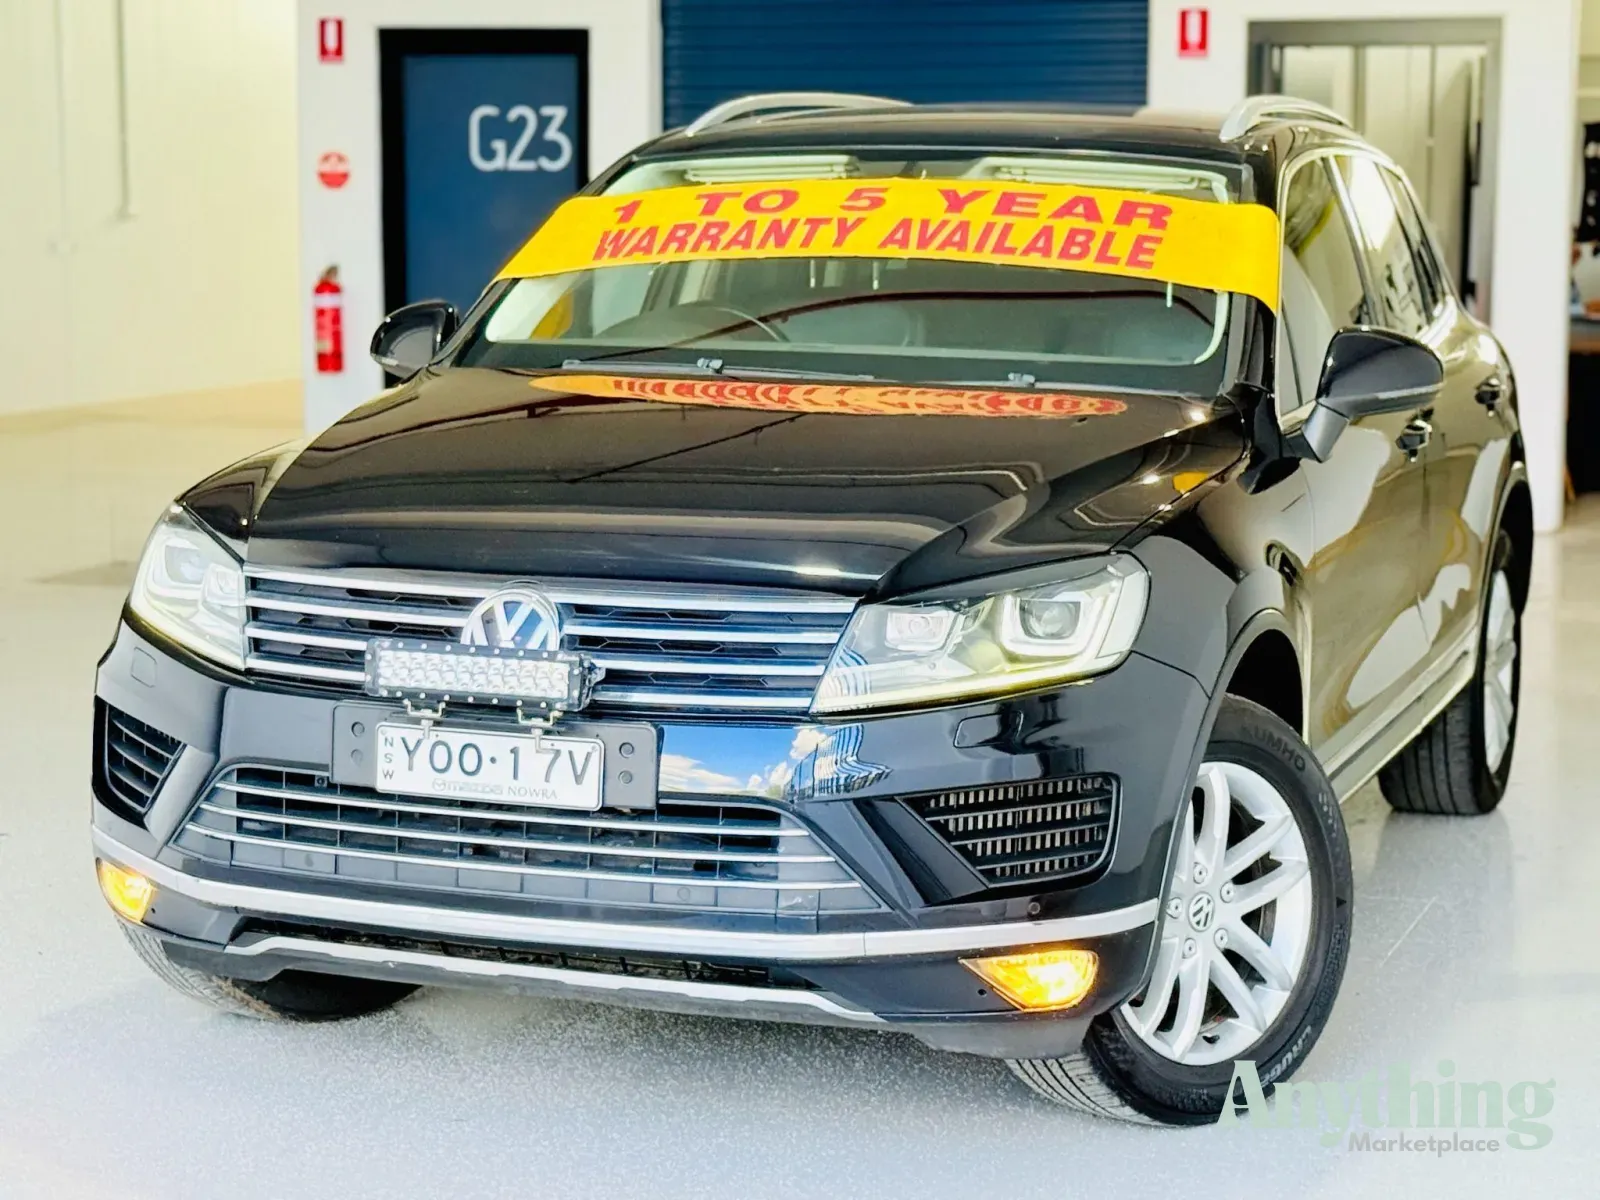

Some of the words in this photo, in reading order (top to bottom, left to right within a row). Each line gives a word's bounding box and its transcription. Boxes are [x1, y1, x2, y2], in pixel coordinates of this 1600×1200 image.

[468, 104, 573, 172] G23
[613, 199, 643, 224] 1
[695, 188, 800, 216] TO
[839, 187, 891, 212] 5
[937, 188, 1173, 230] YEAR
[592, 217, 866, 261] WARRANTY
[877, 217, 1163, 269] AVAILABLE
[507, 785, 557, 800] NOWRA
